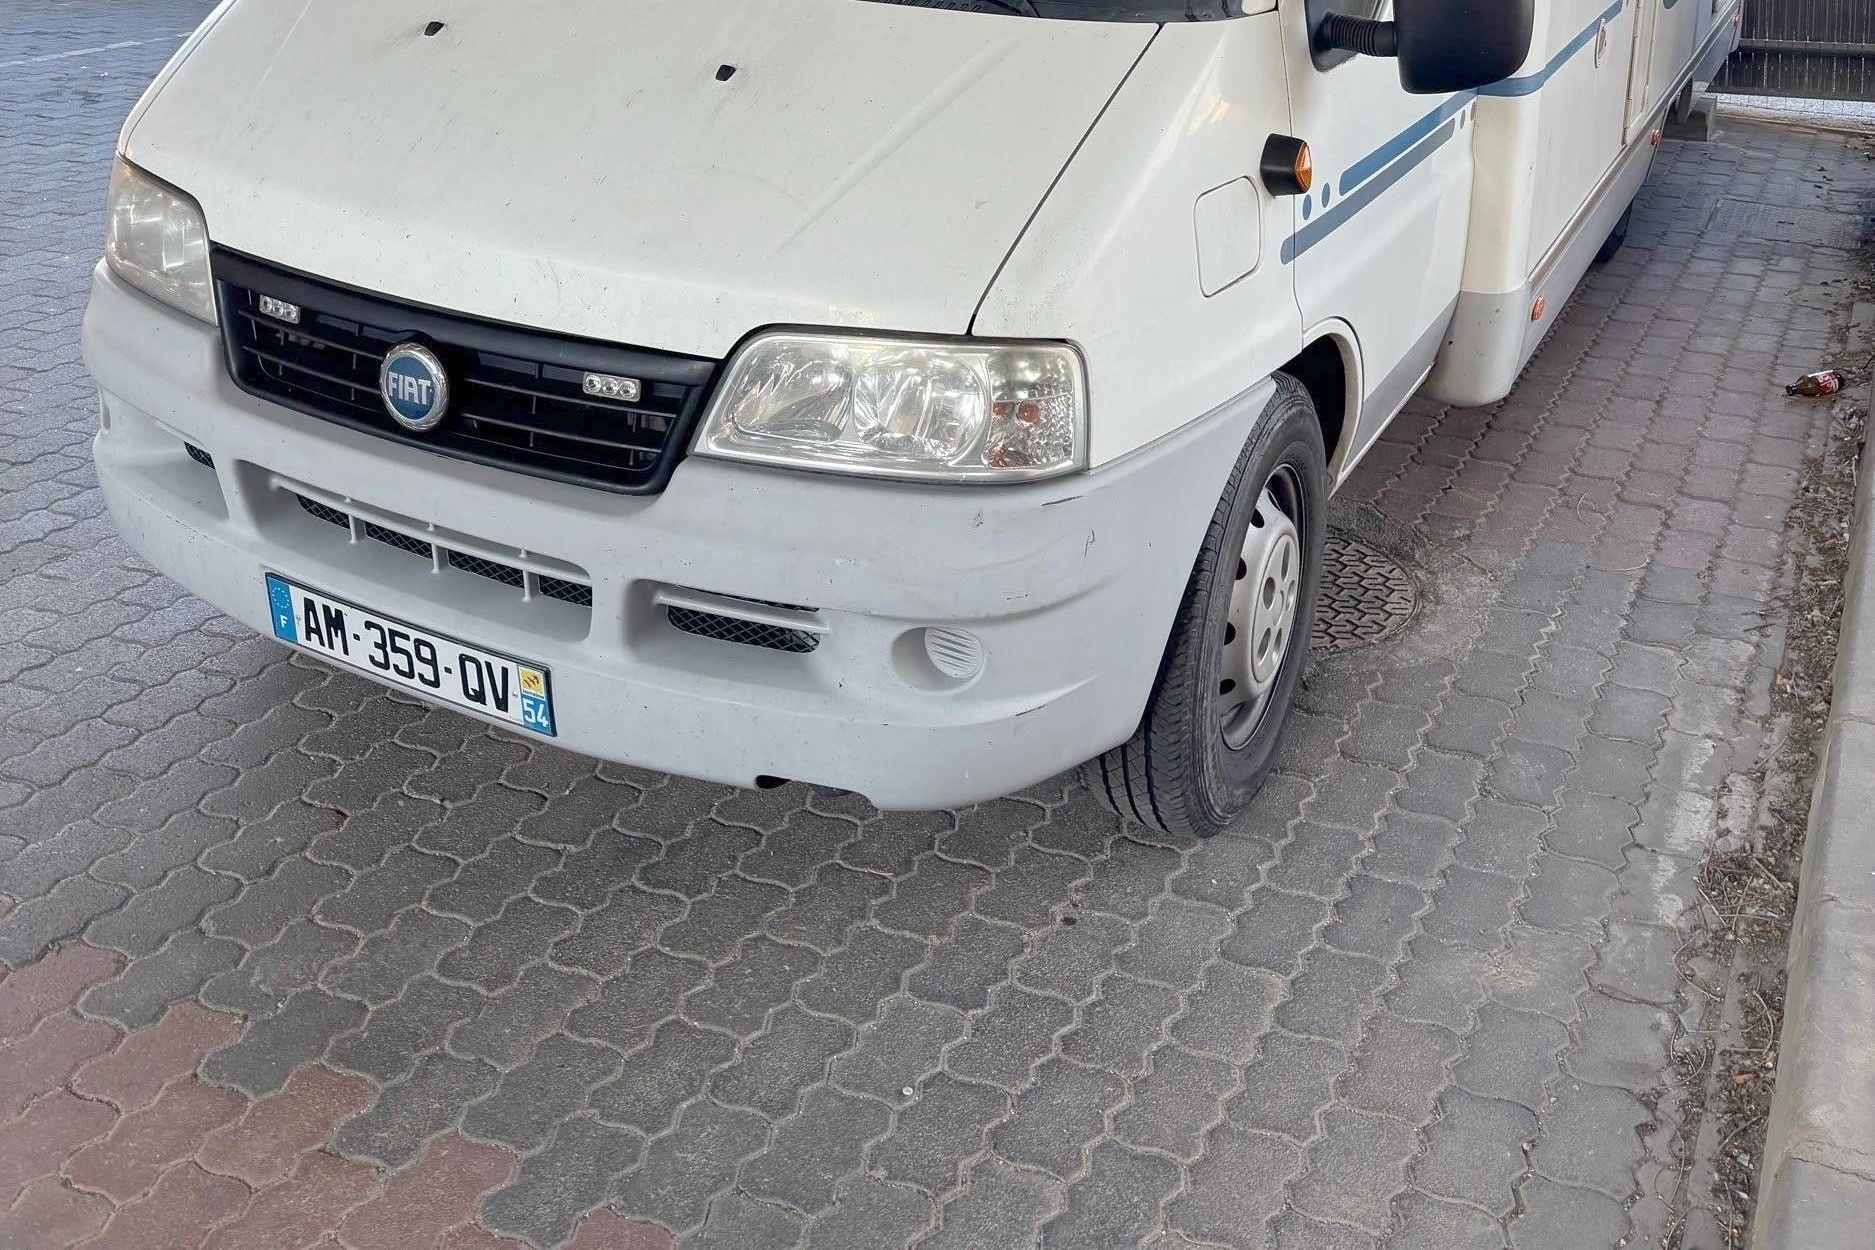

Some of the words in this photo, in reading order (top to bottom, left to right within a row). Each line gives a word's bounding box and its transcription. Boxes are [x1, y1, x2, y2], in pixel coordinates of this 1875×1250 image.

[388, 371, 431, 405] FIAT
[280, 614, 288, 628] F
[303, 596, 509, 713] AM-359-QV
[522, 697, 549, 728] 54
